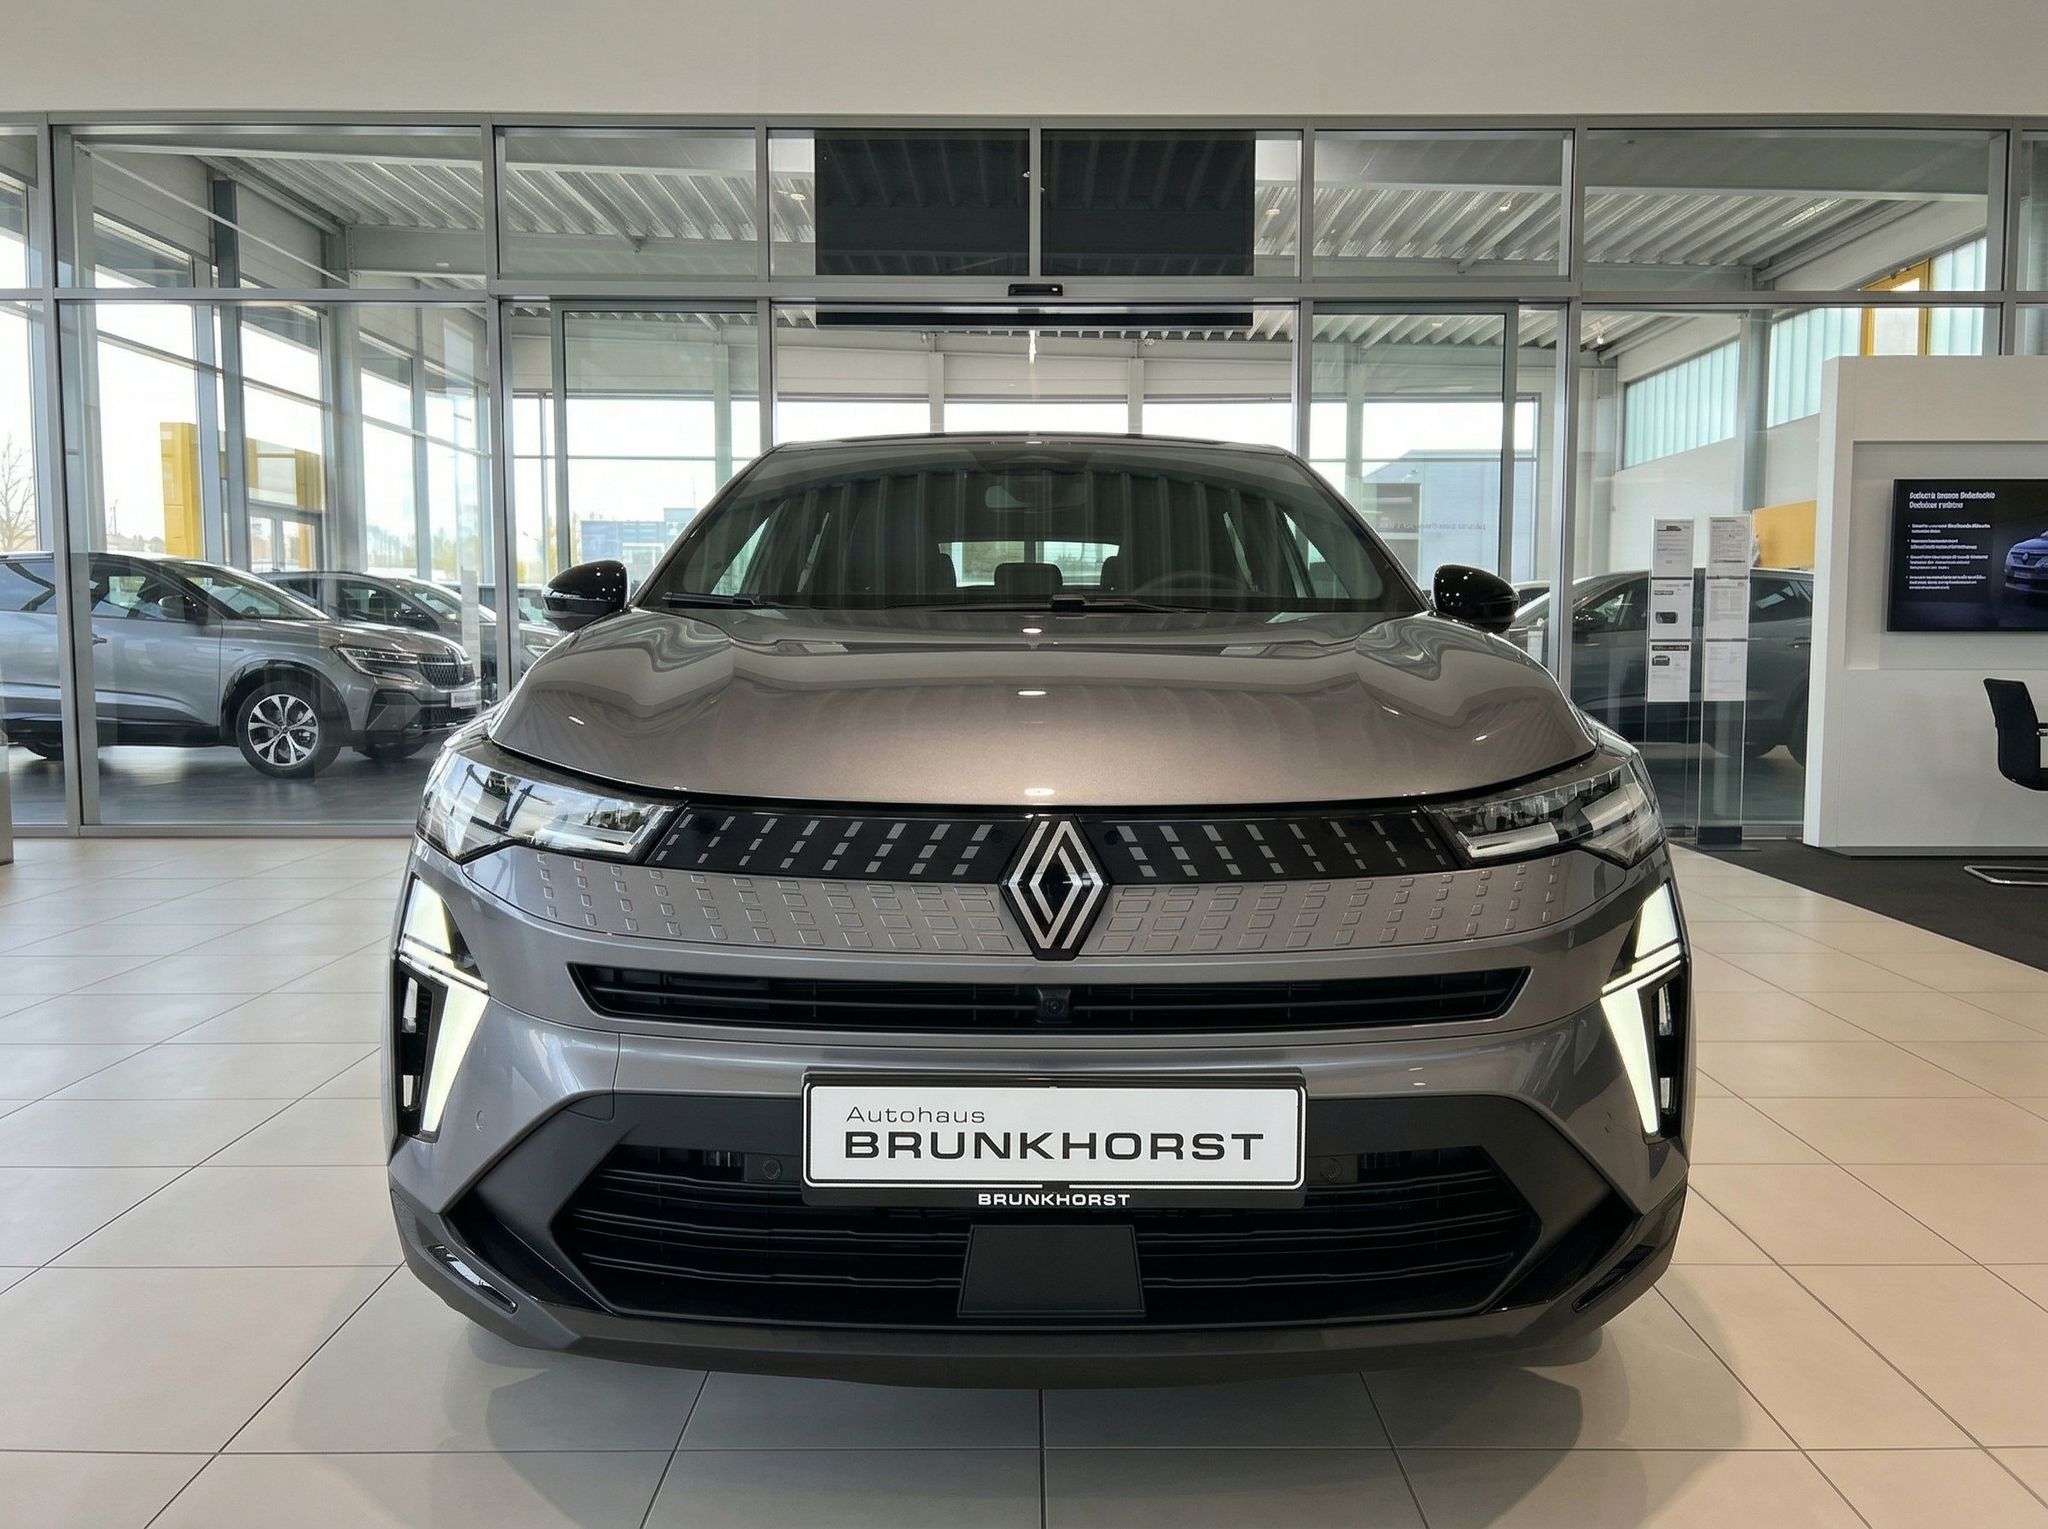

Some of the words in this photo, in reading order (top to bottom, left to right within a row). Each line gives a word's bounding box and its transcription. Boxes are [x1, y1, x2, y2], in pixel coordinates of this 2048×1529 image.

[847, 1107, 984, 1123] Autohaus
[846, 1132, 1263, 1160] BRUNKHORST
[979, 1194, 1130, 1205] BRUNKHORST
